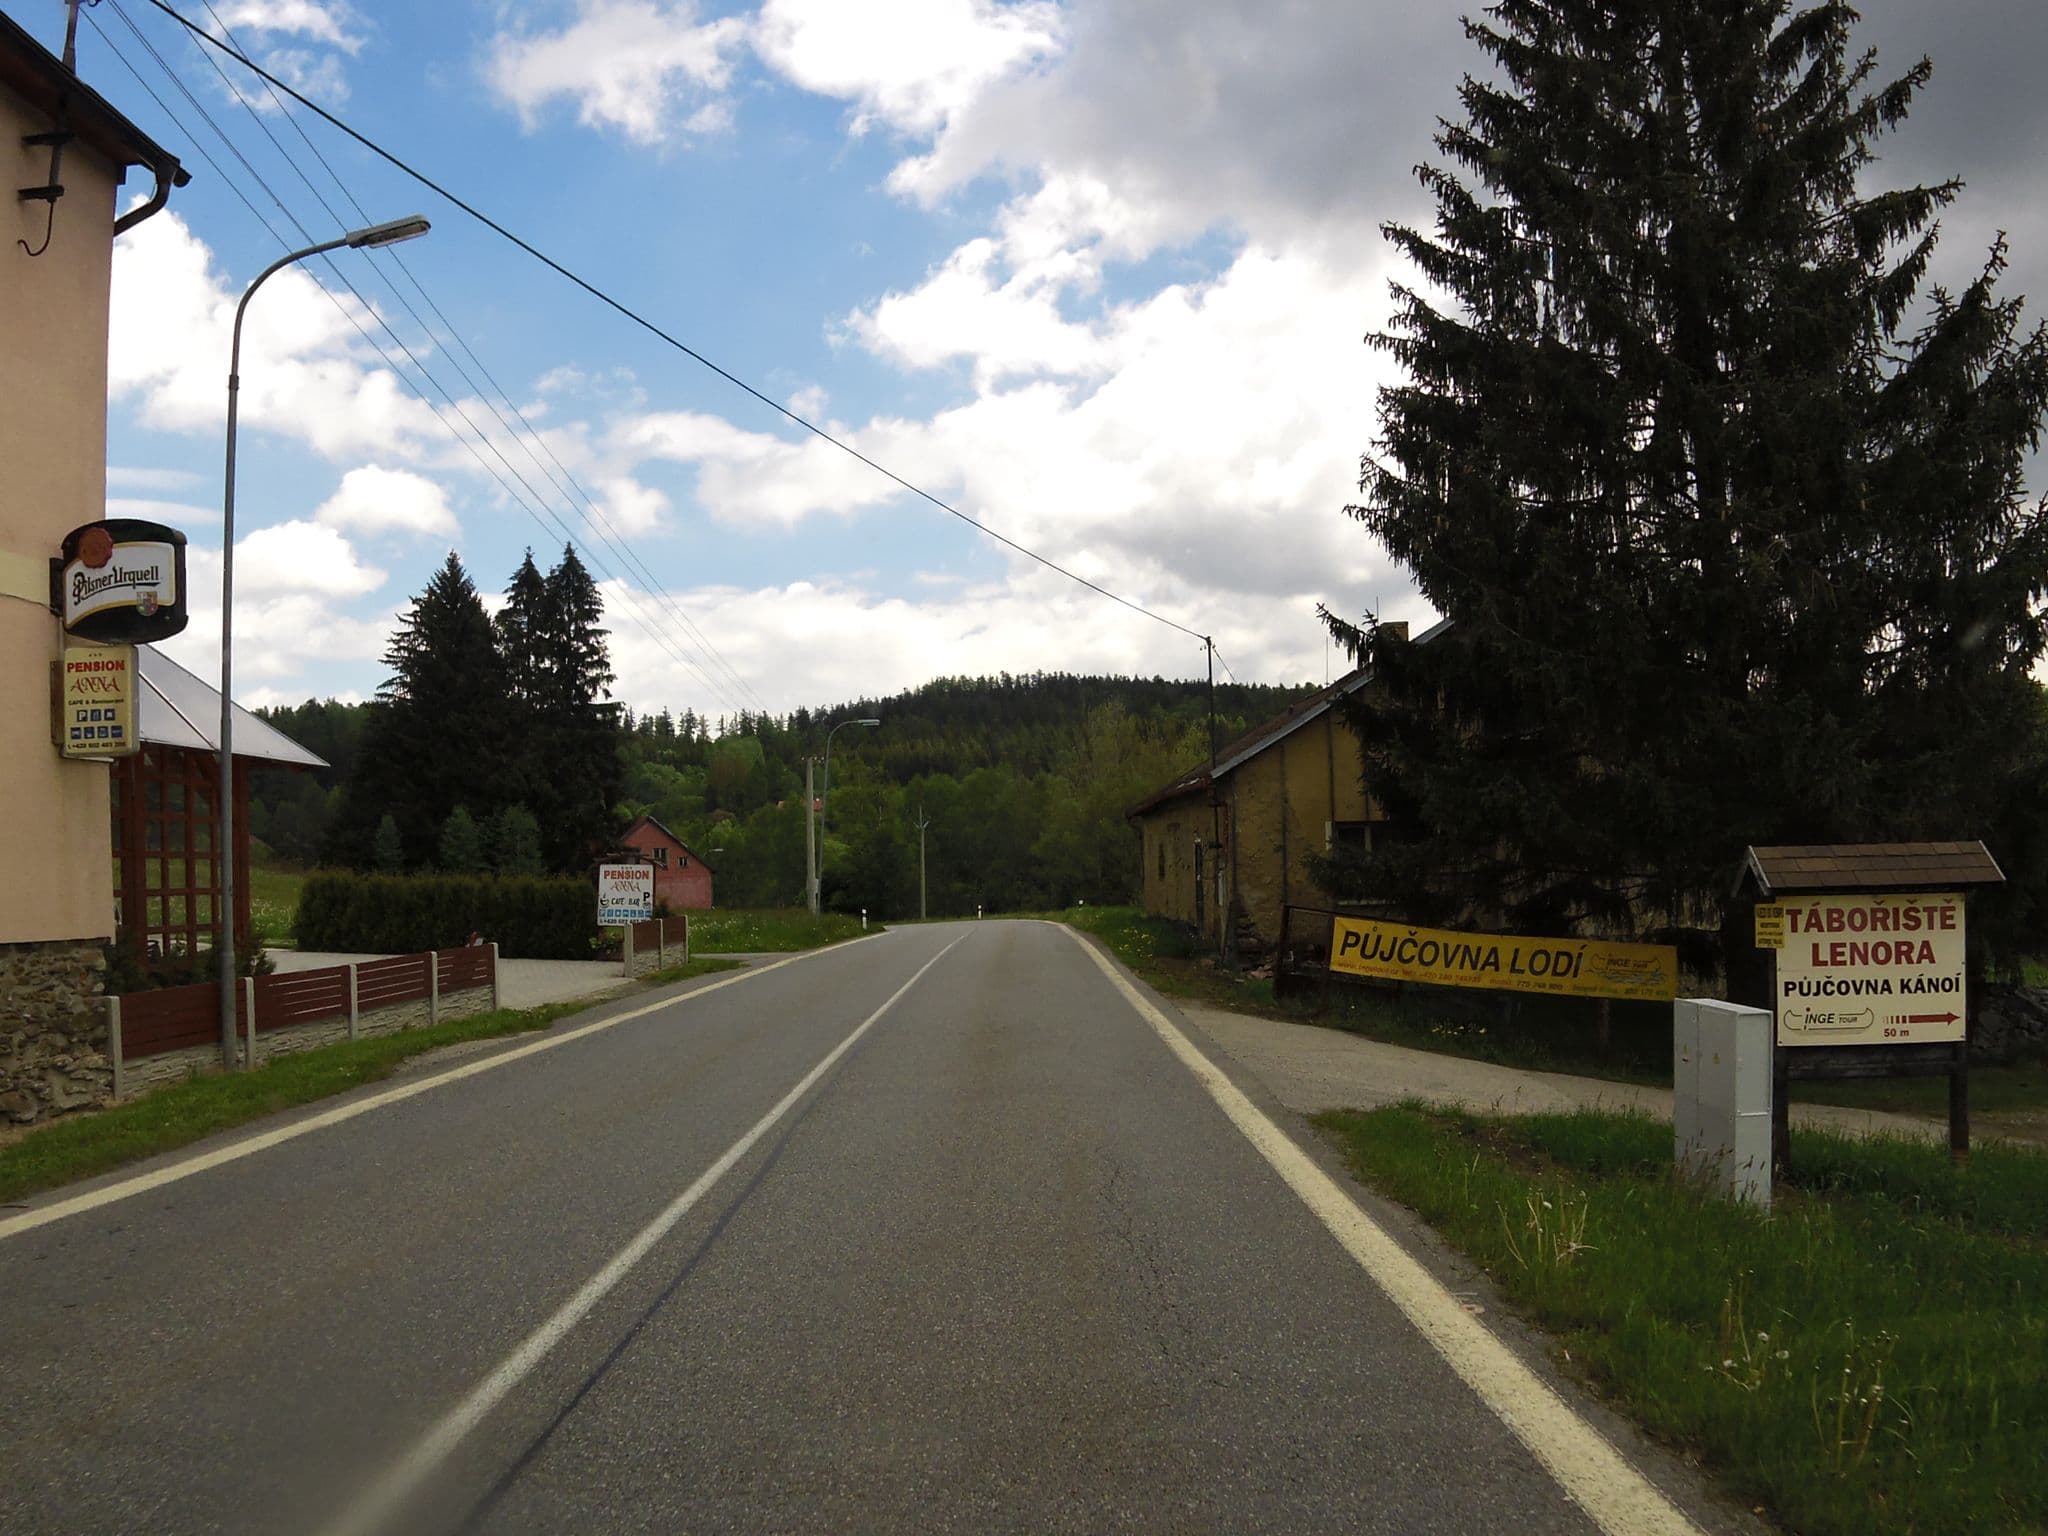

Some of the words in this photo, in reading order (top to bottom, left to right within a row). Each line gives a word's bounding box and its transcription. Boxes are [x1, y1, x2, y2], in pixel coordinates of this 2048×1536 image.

[73, 571, 113, 606] Pilsner
[112, 566, 159, 589] Urquell
[67, 660, 125, 673] PENSION
[70, 676, 120, 693] ANNA
[604, 870, 649, 880] PENSION
[610, 880, 641, 892] ANNA
[1785, 898, 1957, 933] TÁBOŘIŠTĚ
[1339, 926, 1500, 972] PŮJČOVNA
[1510, 944, 1588, 978] LODÍ
[1812, 940, 1936, 967] LENORA
[1784, 975, 1893, 997] PŮJČOVNA
[1900, 973, 1962, 994] KÁNOÍ
[1838, 1016, 1858, 1024] TOUR
[1883, 1028, 1897, 1037] 50
[1900, 1029, 1909, 1037] m
